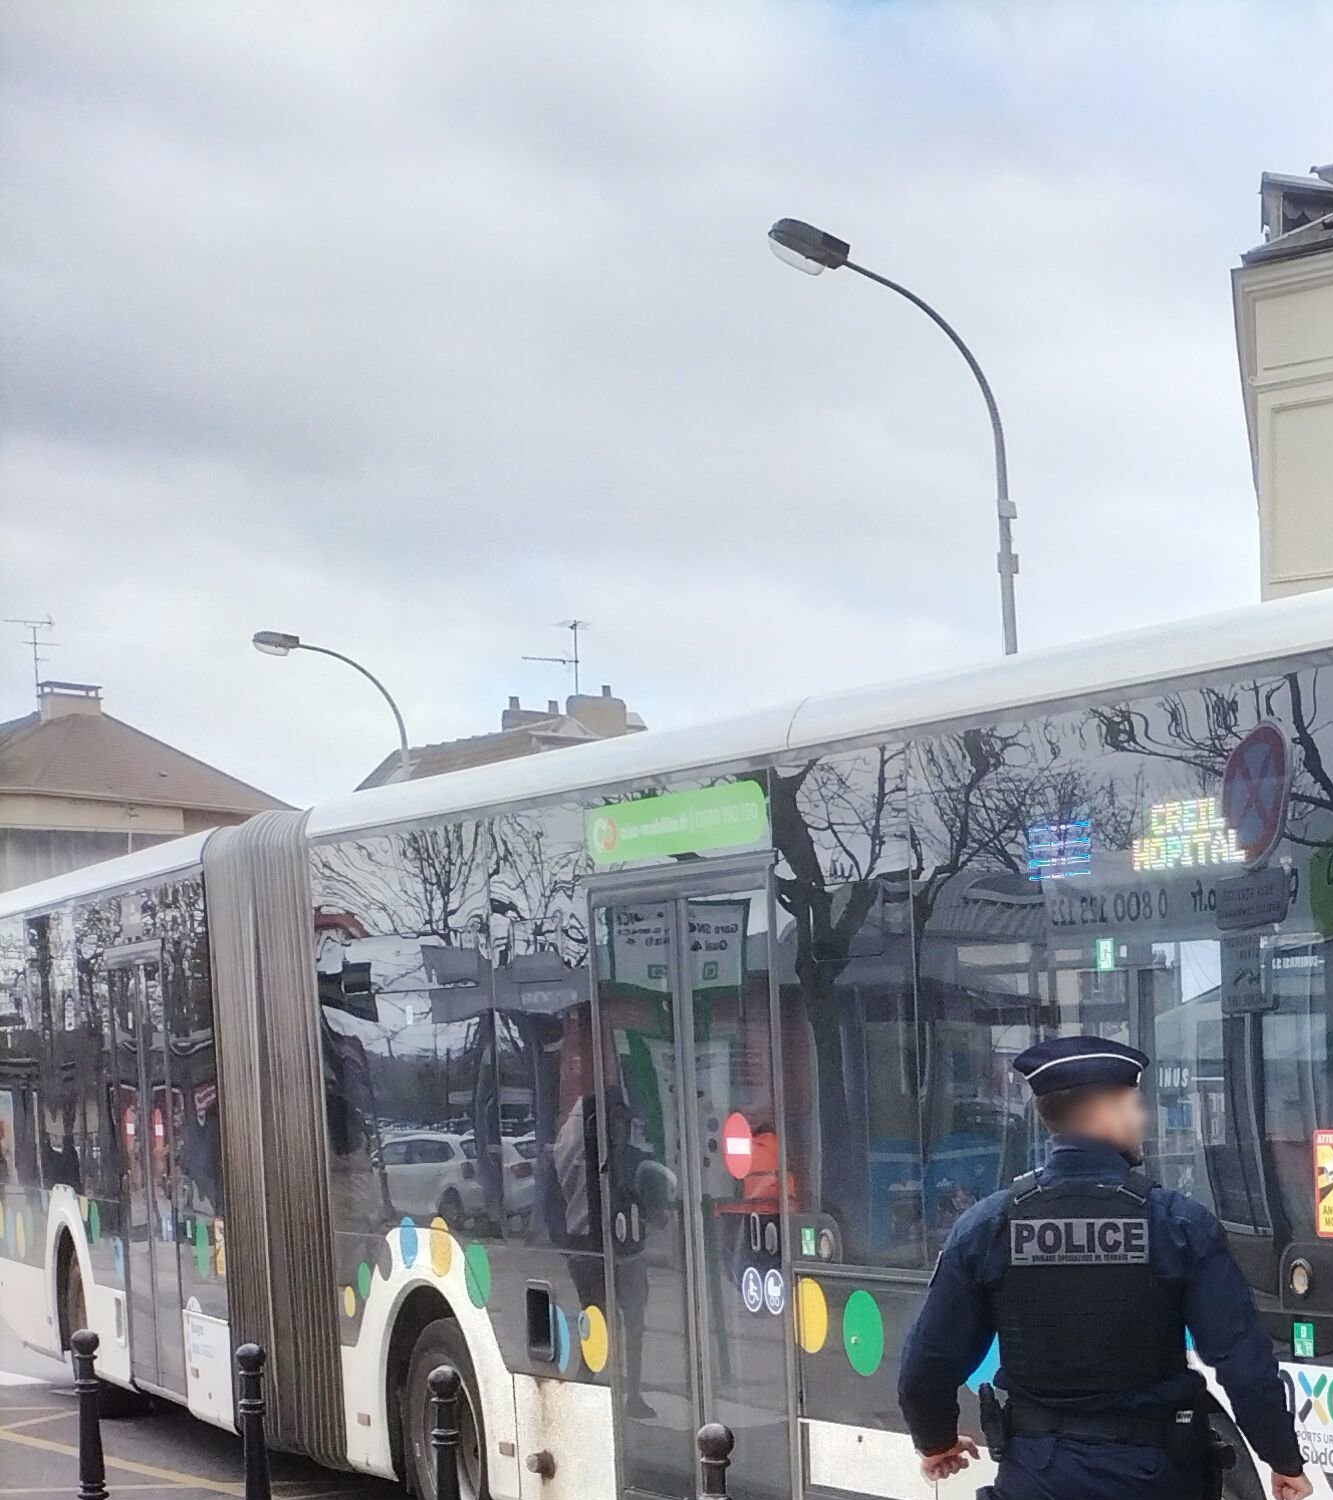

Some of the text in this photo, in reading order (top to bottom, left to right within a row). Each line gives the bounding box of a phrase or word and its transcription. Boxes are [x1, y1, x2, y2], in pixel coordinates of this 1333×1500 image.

[1151, 798, 1226, 834] CREIL
[1132, 828, 1246, 872] HOPITAL
[1014, 1221, 1146, 1254] POLICE
[1296, 1430, 1321, 1443] PORTS
